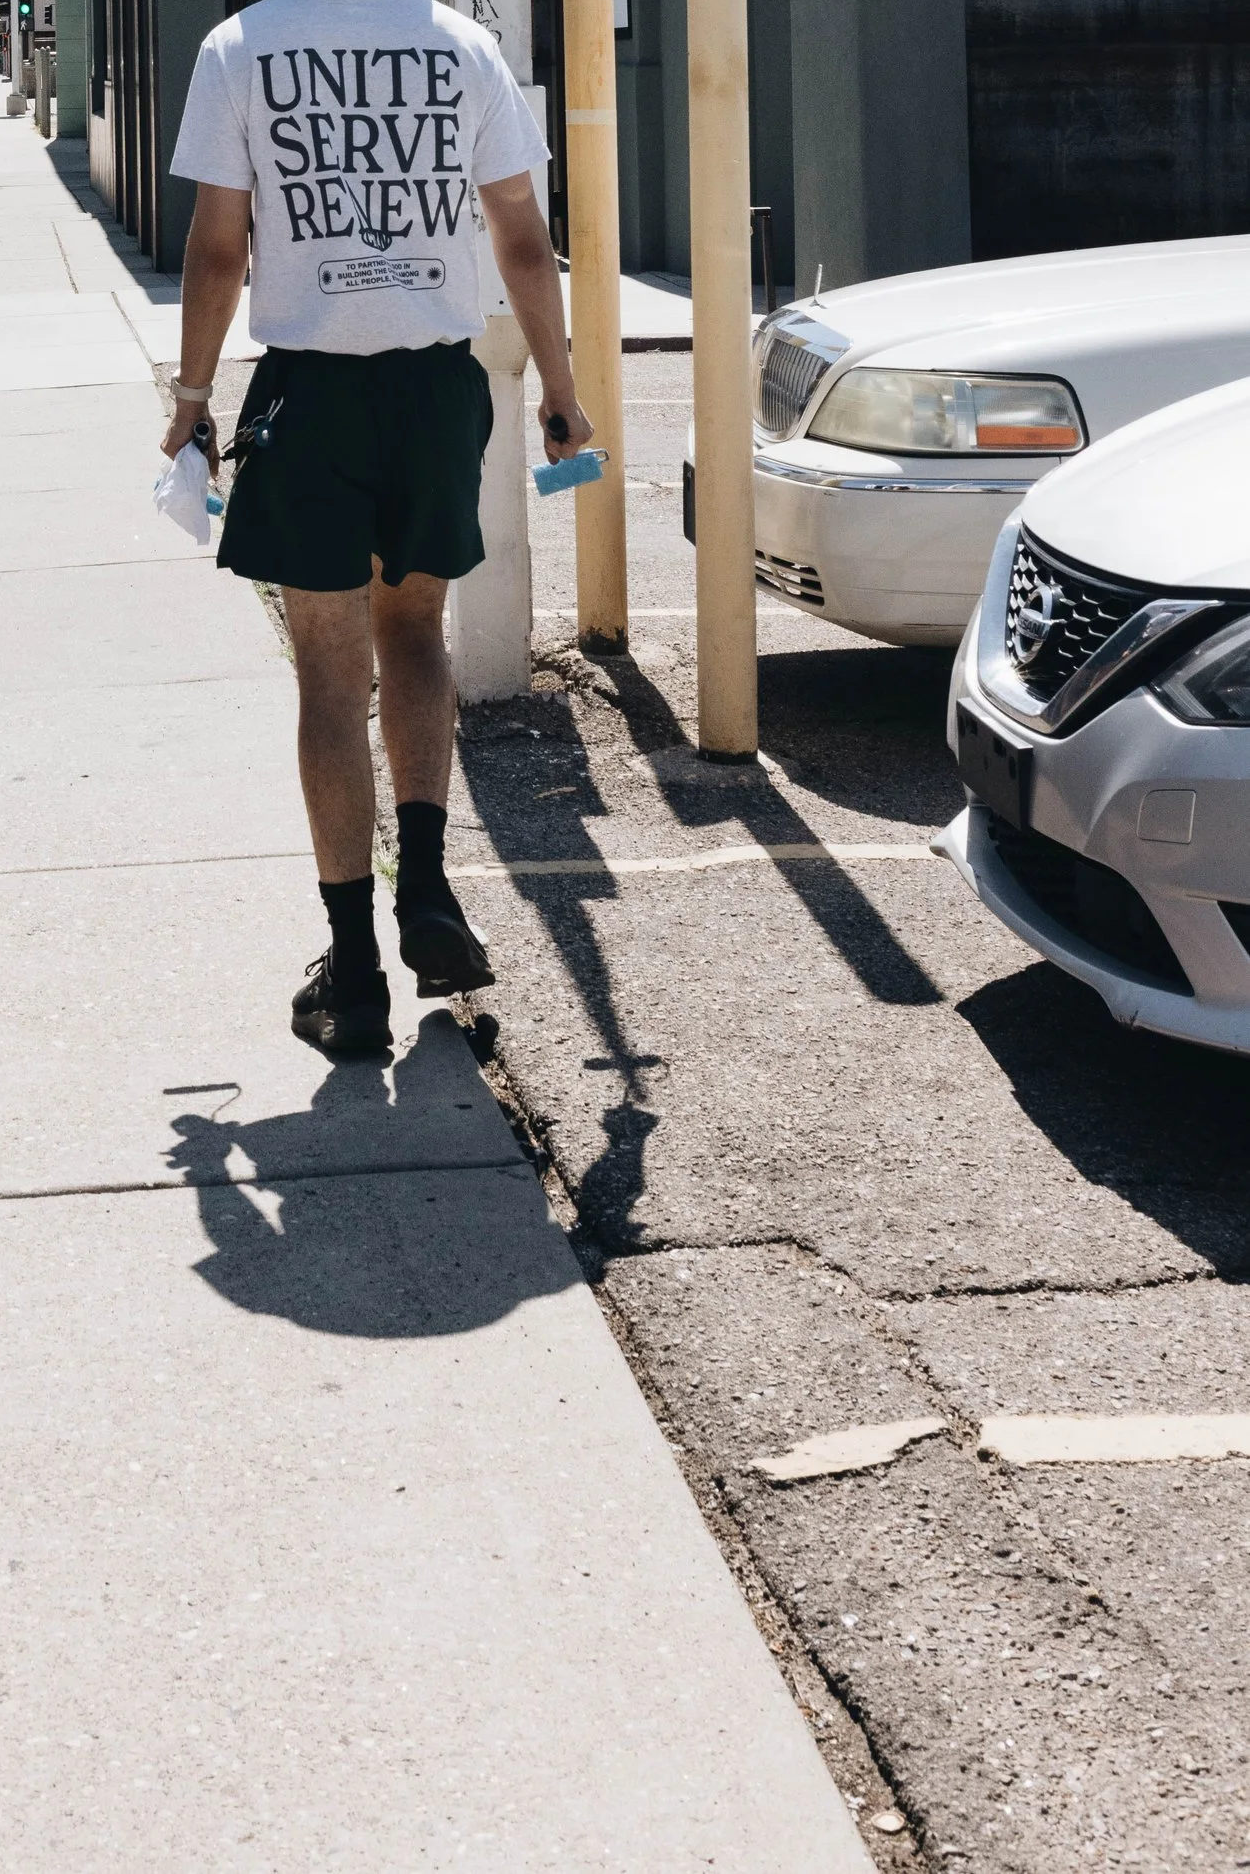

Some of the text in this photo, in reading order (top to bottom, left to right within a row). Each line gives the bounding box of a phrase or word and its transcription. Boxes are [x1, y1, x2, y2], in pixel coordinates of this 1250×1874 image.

[256, 47, 464, 113] UNITE
[269, 111, 464, 179] SERVE
[279, 175, 468, 243] RENEW
[337, 270, 373, 280] BUILDING
[374, 267, 388, 276] THE
[345, 280, 359, 288] ALL
[361, 275, 392, 286] PEOPLE,
[346, 263, 356, 271] TO
[403, 262, 411, 270] IN
